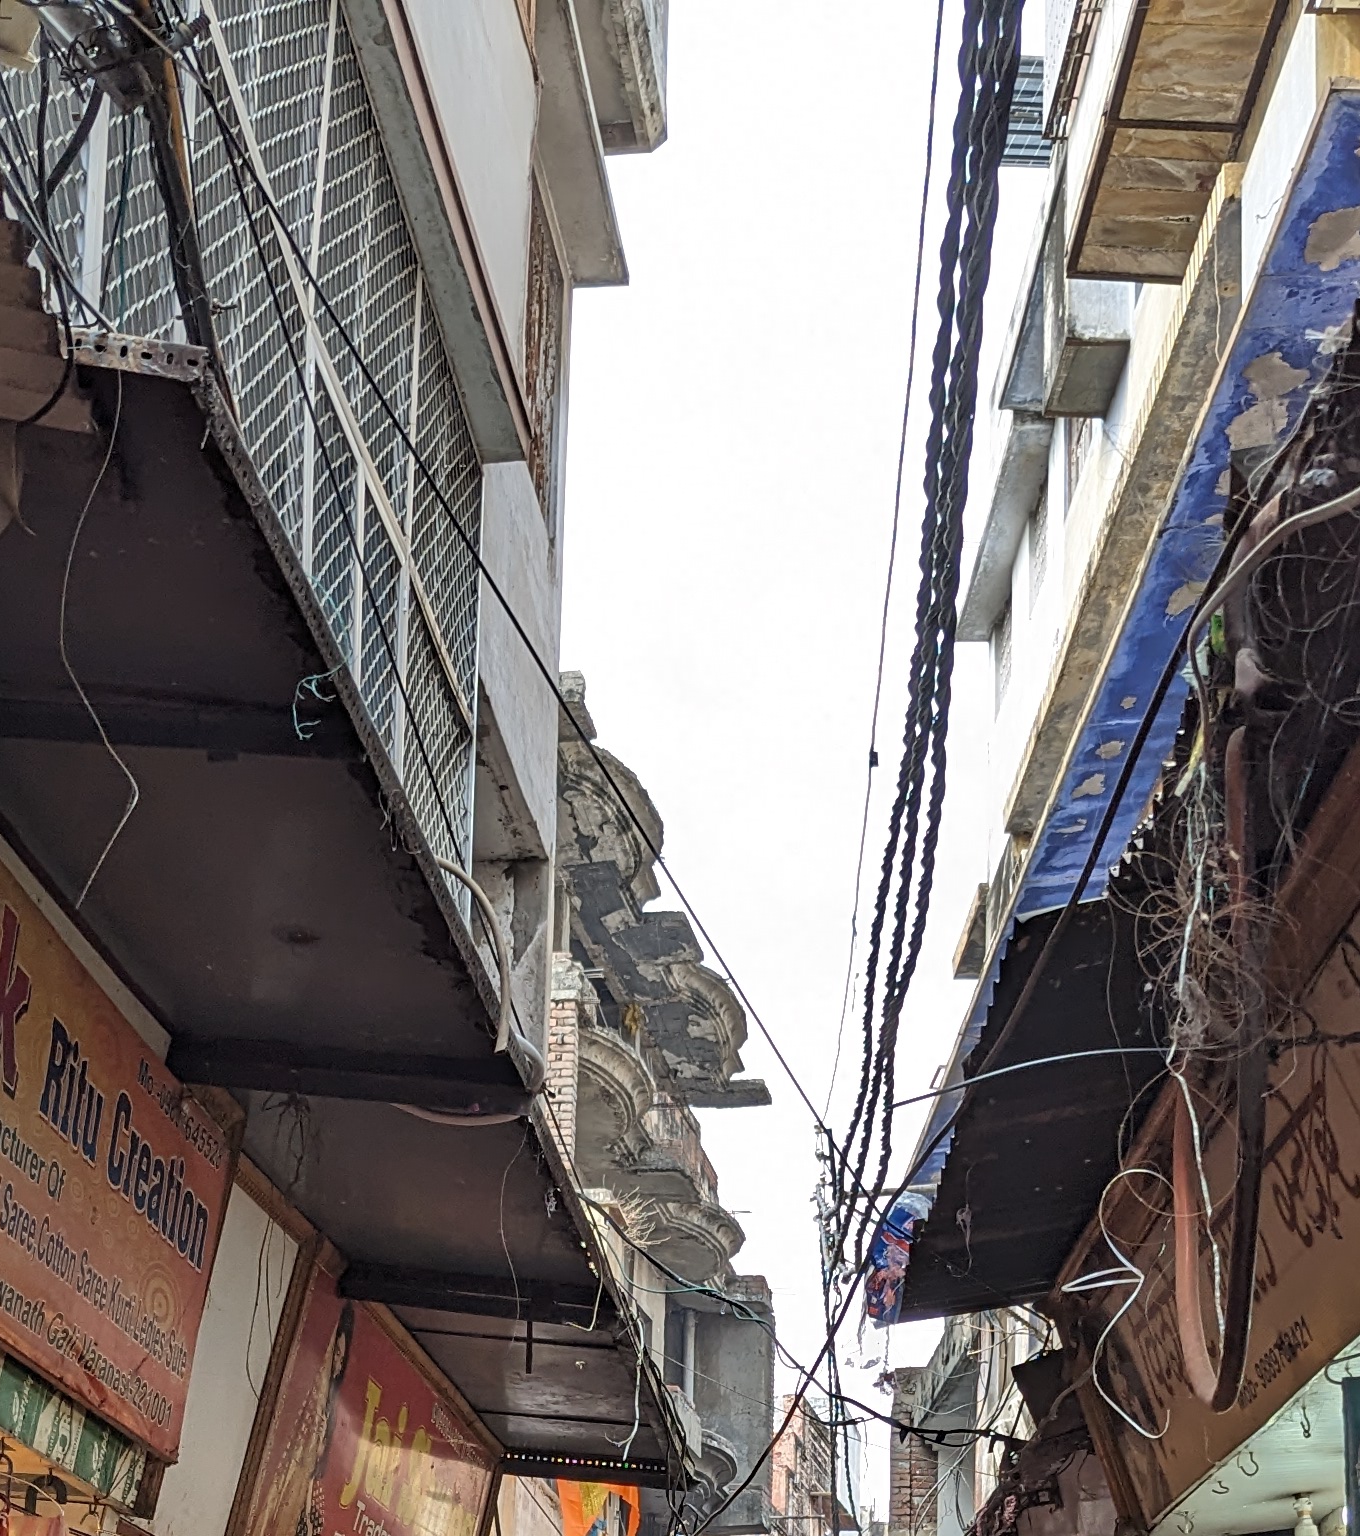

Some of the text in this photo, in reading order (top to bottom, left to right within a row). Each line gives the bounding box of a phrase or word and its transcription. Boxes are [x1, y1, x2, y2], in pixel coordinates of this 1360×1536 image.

[39, 1014, 209, 1274] Ritu Creation
[46, 1159, 66, 1202] Of
[76, 1249, 109, 1310] Saree
